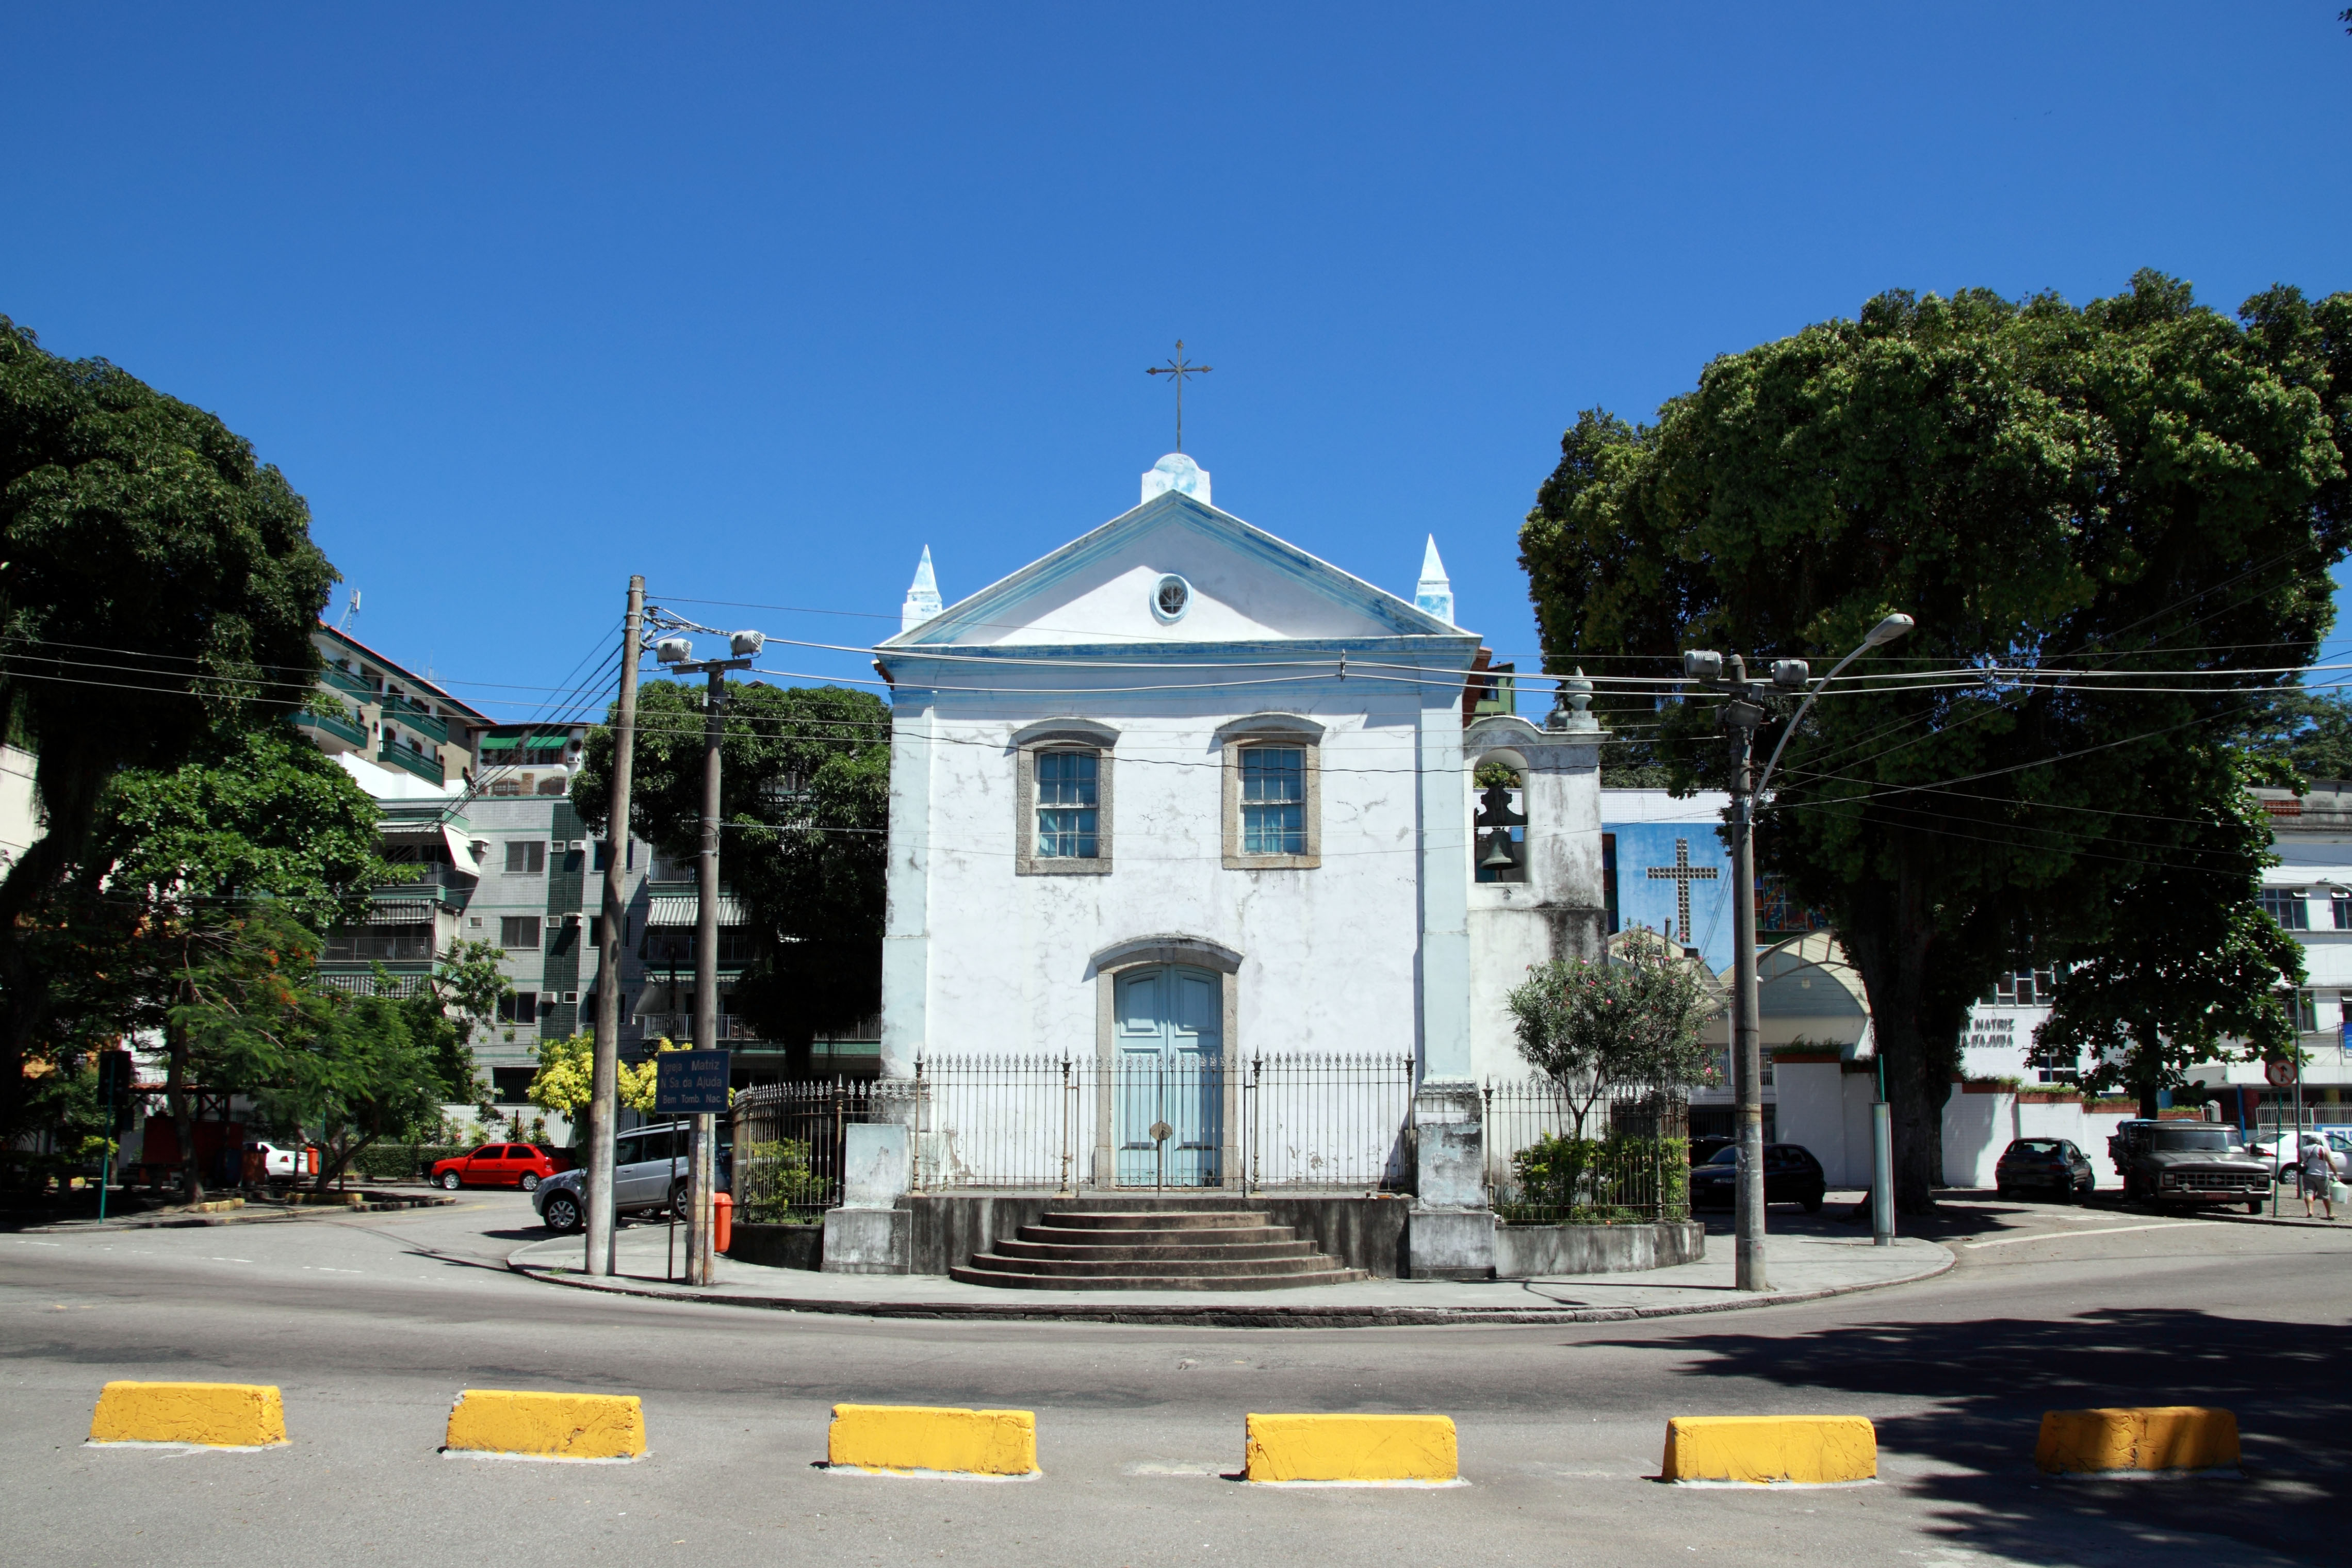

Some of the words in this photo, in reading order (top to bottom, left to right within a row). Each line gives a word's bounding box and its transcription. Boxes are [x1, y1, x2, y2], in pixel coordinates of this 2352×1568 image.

[1974, 1018, 2015, 1032] MATRIZ
[664, 1062, 682, 1075] Igreja
[692, 1059, 720, 1071] Matriz
[683, 1077, 692, 1087] da
[696, 1076, 722, 1089] Ajuda
[663, 1095, 677, 1104] Bem
[681, 1093, 701, 1103] Tomb.
[706, 1093, 723, 1103] Nac.
